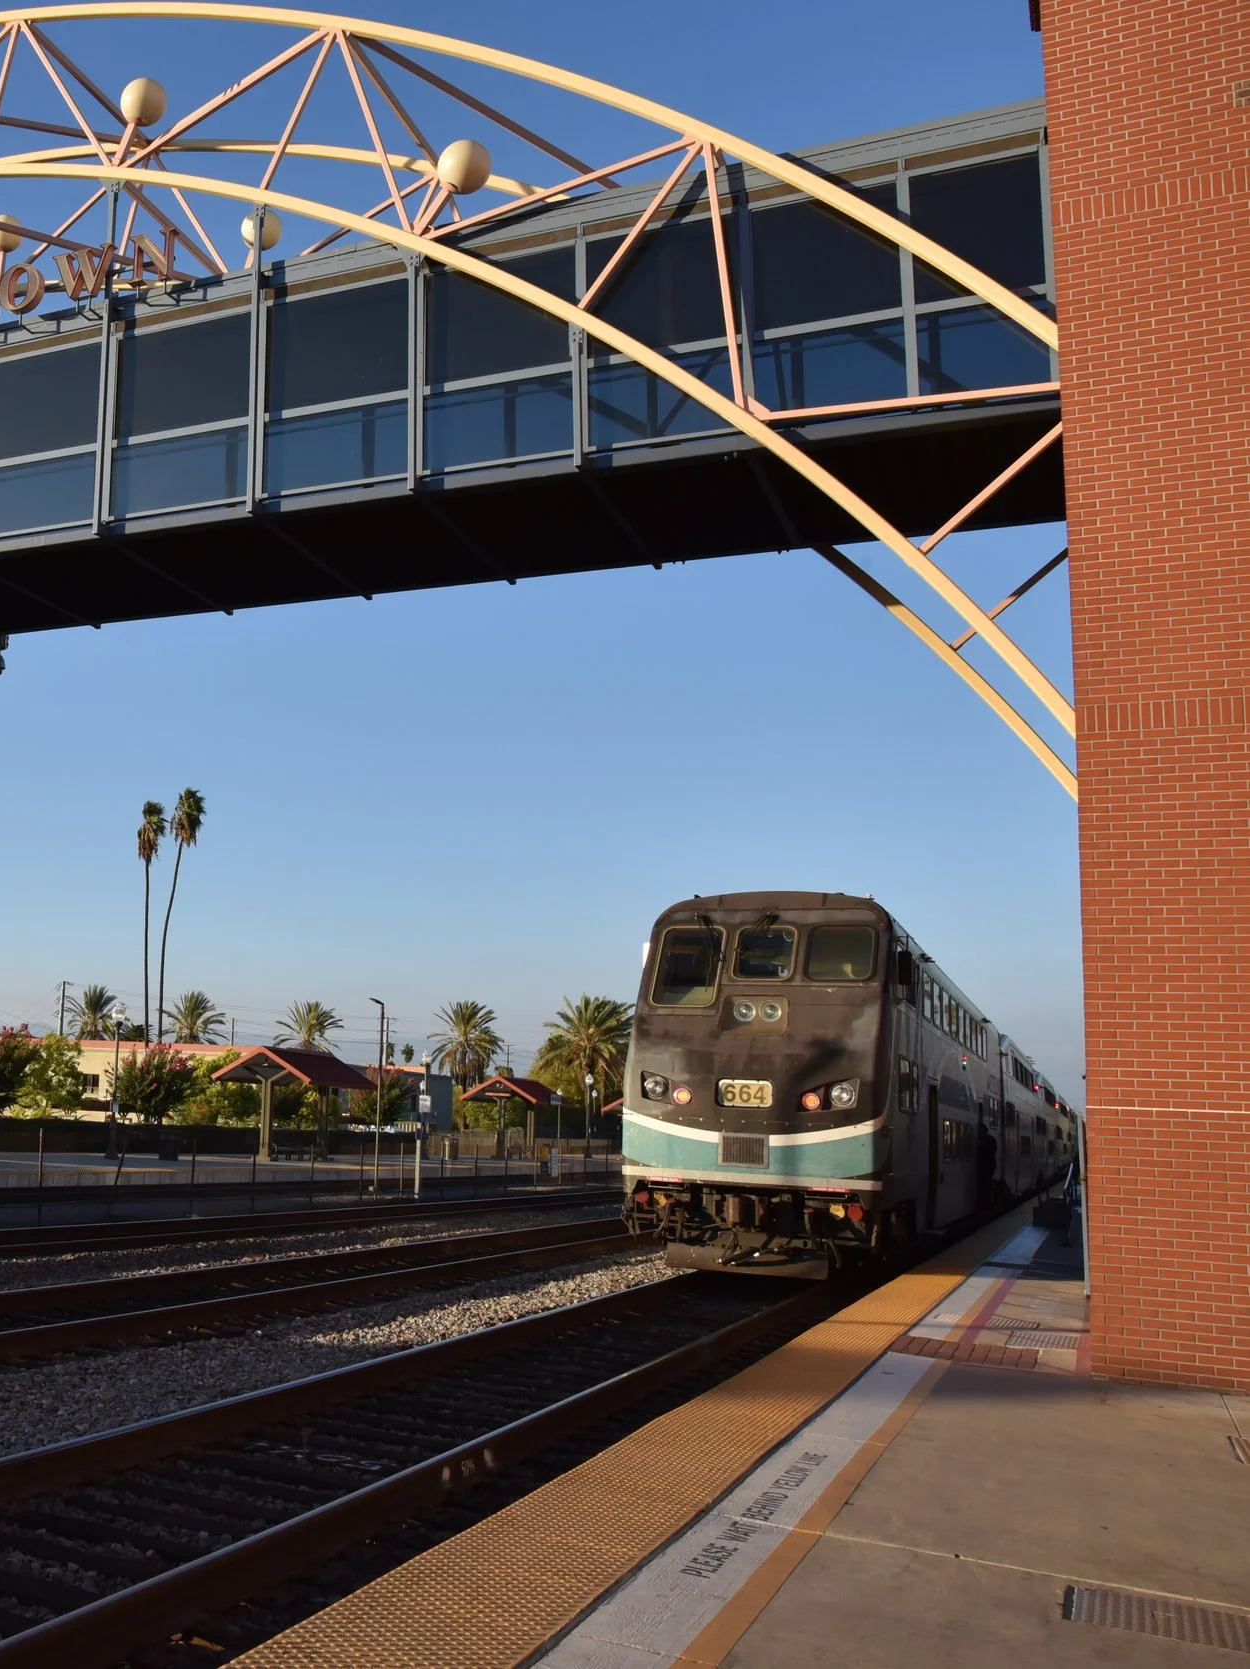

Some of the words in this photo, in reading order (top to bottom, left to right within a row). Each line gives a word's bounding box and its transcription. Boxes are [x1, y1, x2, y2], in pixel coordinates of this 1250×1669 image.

[723, 1083, 767, 1104] 664
[679, 1542, 739, 1580] PLEASE
[716, 1520, 761, 1543] WAIT
[741, 1491, 789, 1522] BEHIND
[772, 1464, 813, 1491] YELLOW
[795, 1451, 829, 1467] LINE
